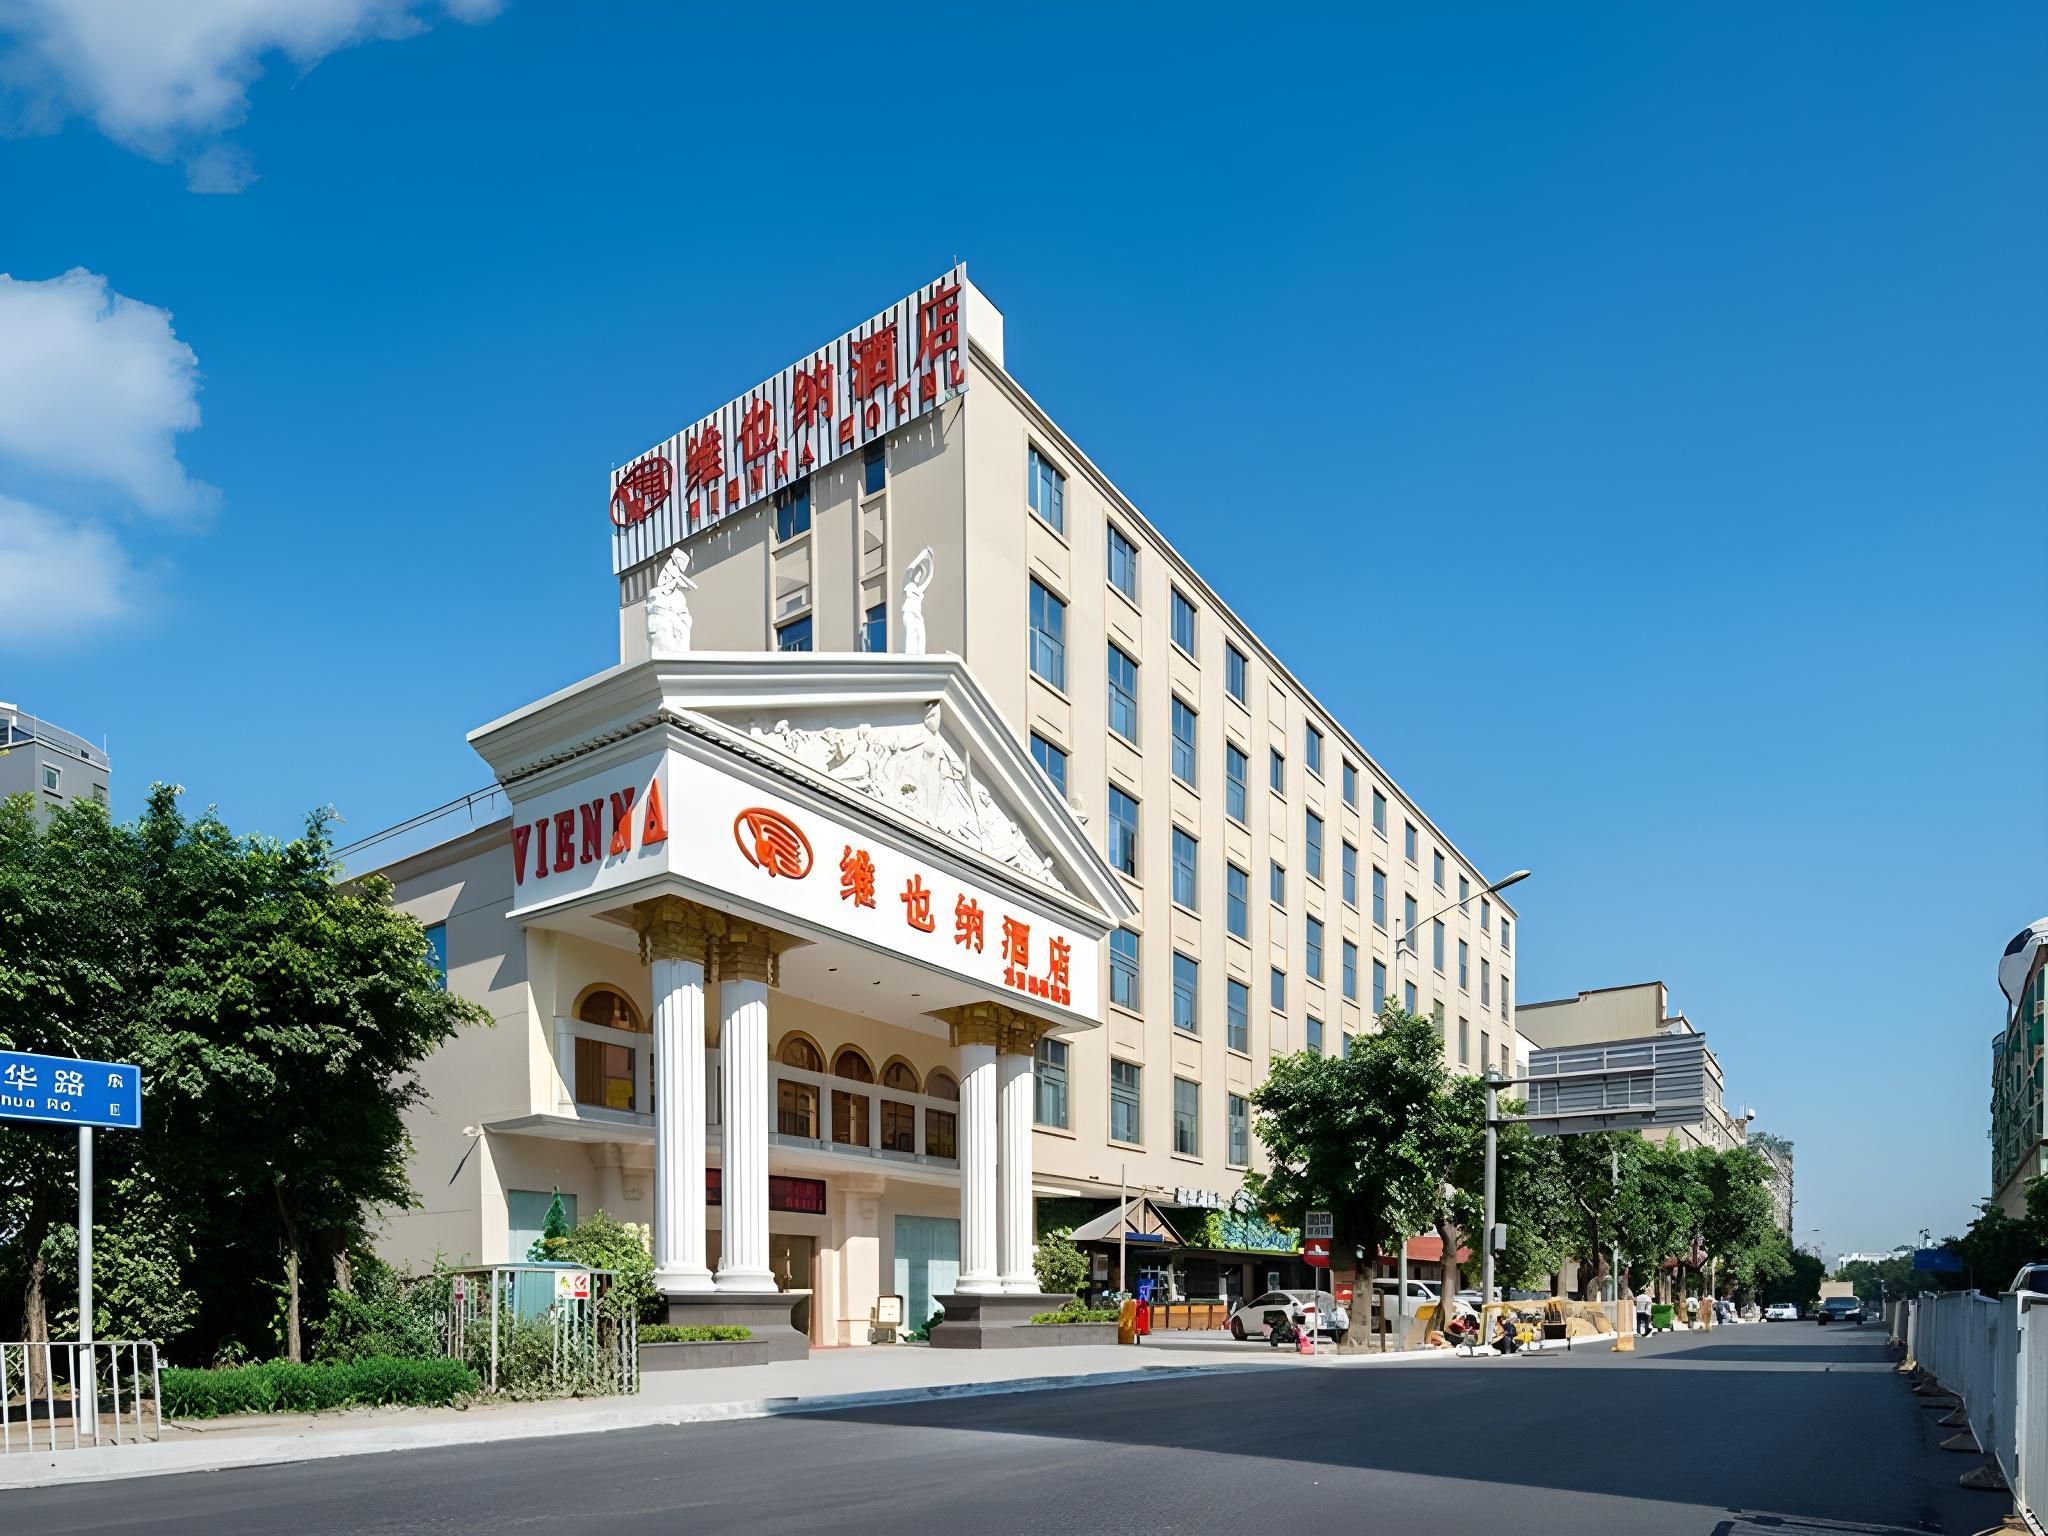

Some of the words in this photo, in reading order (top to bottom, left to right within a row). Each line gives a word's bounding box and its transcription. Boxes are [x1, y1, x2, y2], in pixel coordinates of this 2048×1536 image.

[686, 284, 961, 498] 维也纳酒店
[511, 778, 668, 886] VIENNA
[840, 845, 1071, 988] 维也纳酒店
